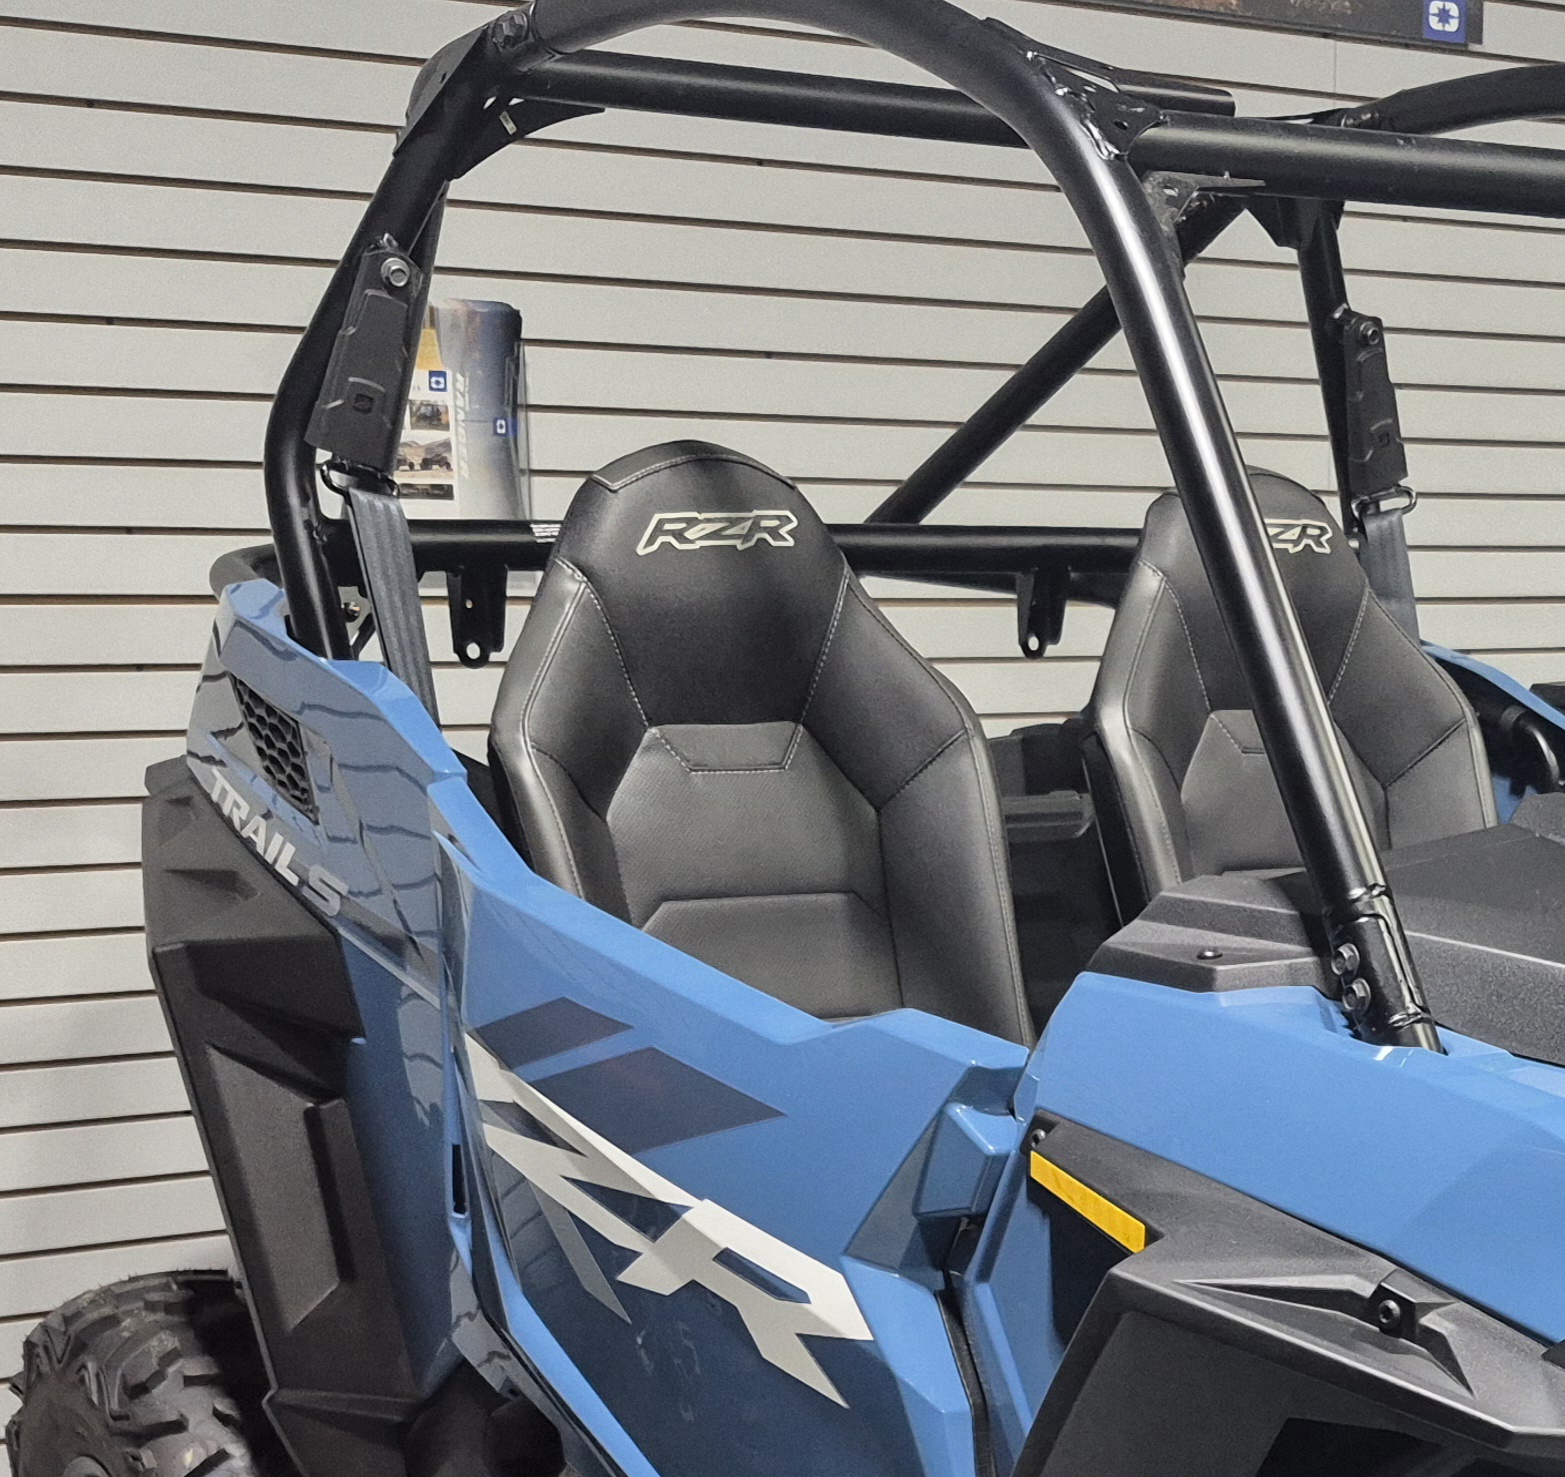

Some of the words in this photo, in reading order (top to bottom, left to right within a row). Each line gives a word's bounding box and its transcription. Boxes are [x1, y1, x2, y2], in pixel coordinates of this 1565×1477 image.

[637, 510, 798, 556] RZR
[1264, 518, 1333, 554] ZR
[211, 767, 299, 887] TRAIL
[302, 864, 349, 917] S
